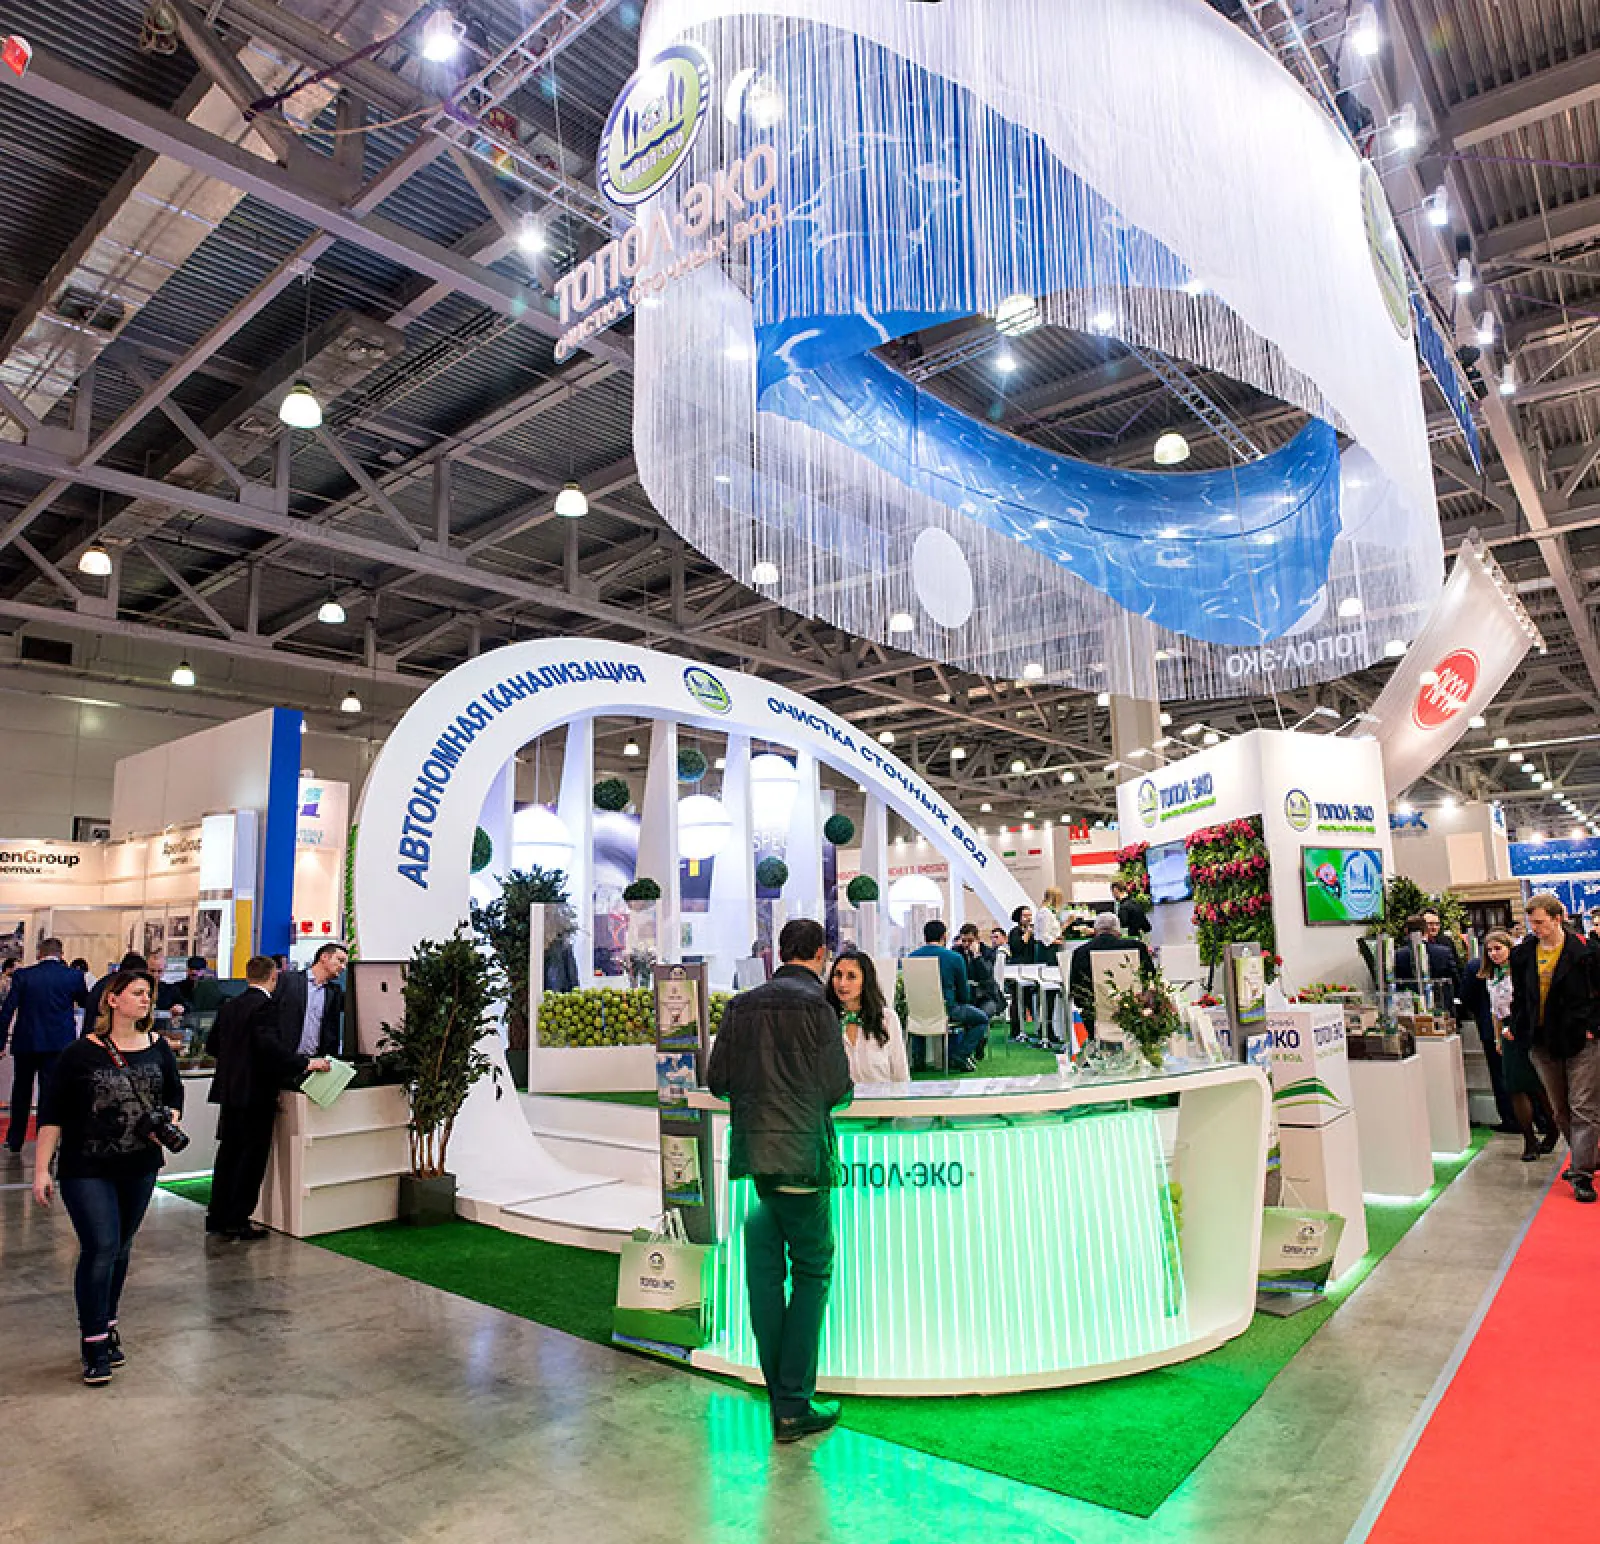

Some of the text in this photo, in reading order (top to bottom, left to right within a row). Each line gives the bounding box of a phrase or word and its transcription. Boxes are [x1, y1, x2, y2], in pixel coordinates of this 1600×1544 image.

[733, 203, 782, 246] ВОД
[397, 660, 646, 889] АВТОНОМНАЯ КАНАЛИЗАЦИЯ
[767, 697, 988, 868] ОЧИСТКА СТОЧНЫХ ВОД
